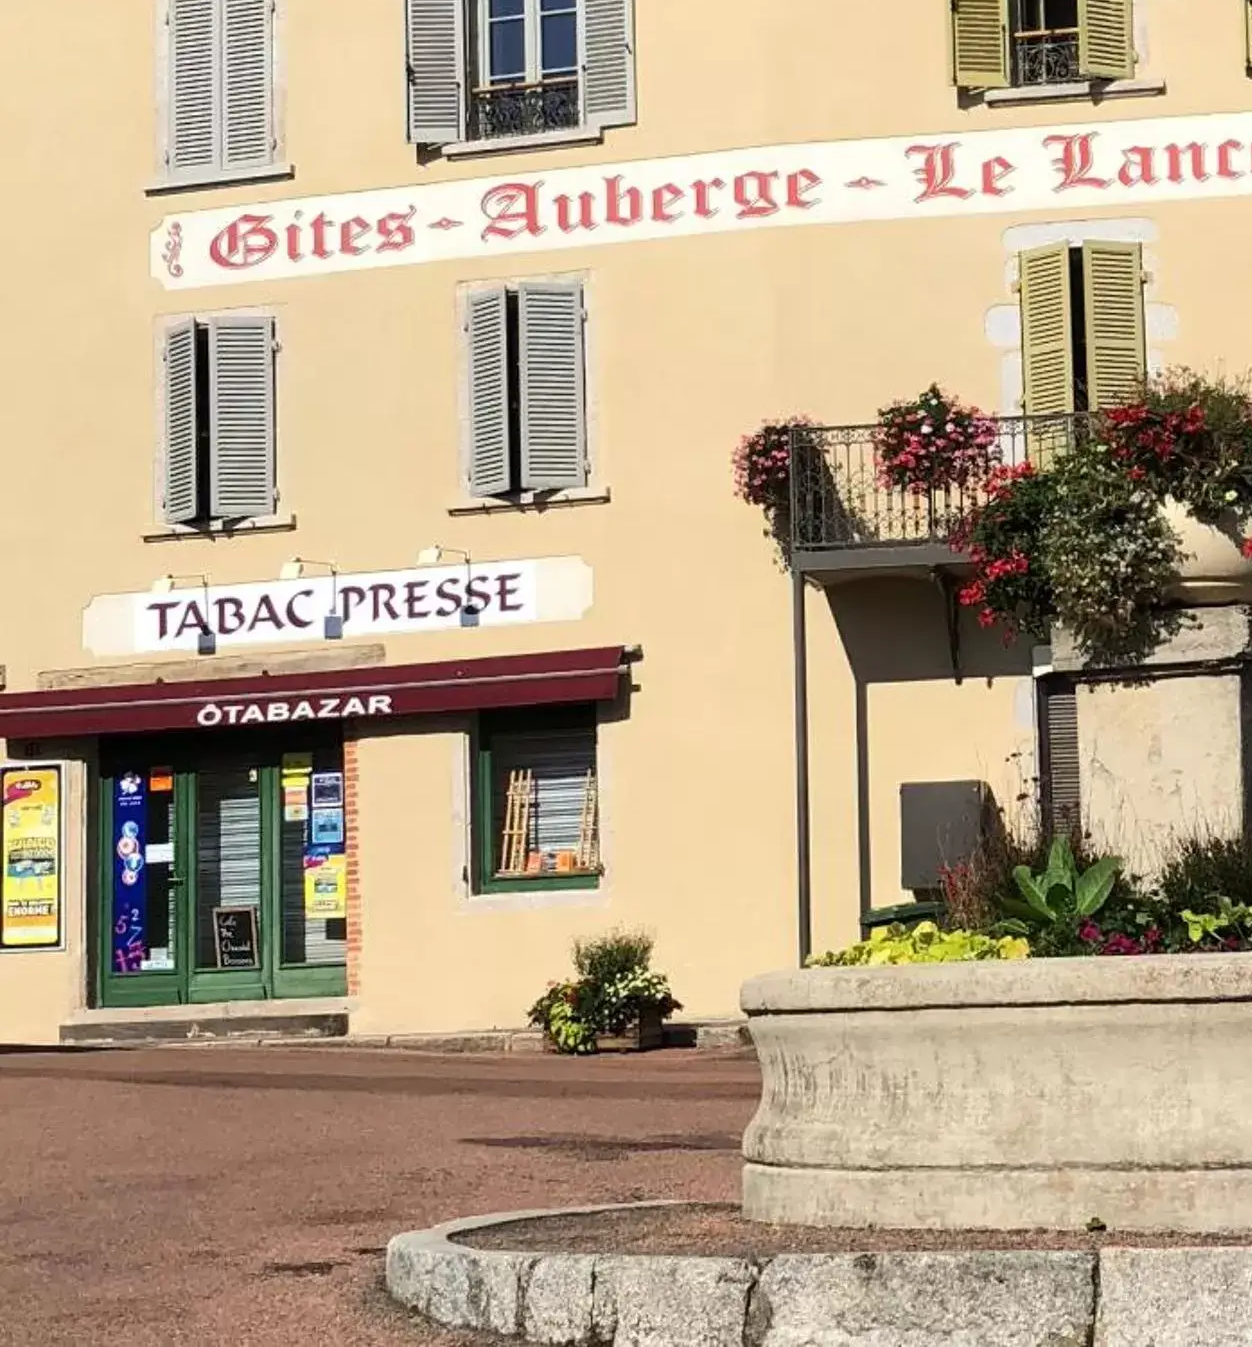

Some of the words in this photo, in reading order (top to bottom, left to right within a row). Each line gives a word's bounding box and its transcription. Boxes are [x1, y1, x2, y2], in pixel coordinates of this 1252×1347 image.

[480, 167, 824, 243] Auberge
[904, 140, 1018, 204] Le
[147, 589, 315, 641] TABAC
[337, 572, 525, 625] PRESSE
[196, 693, 393, 728] ÔTABAZAR
